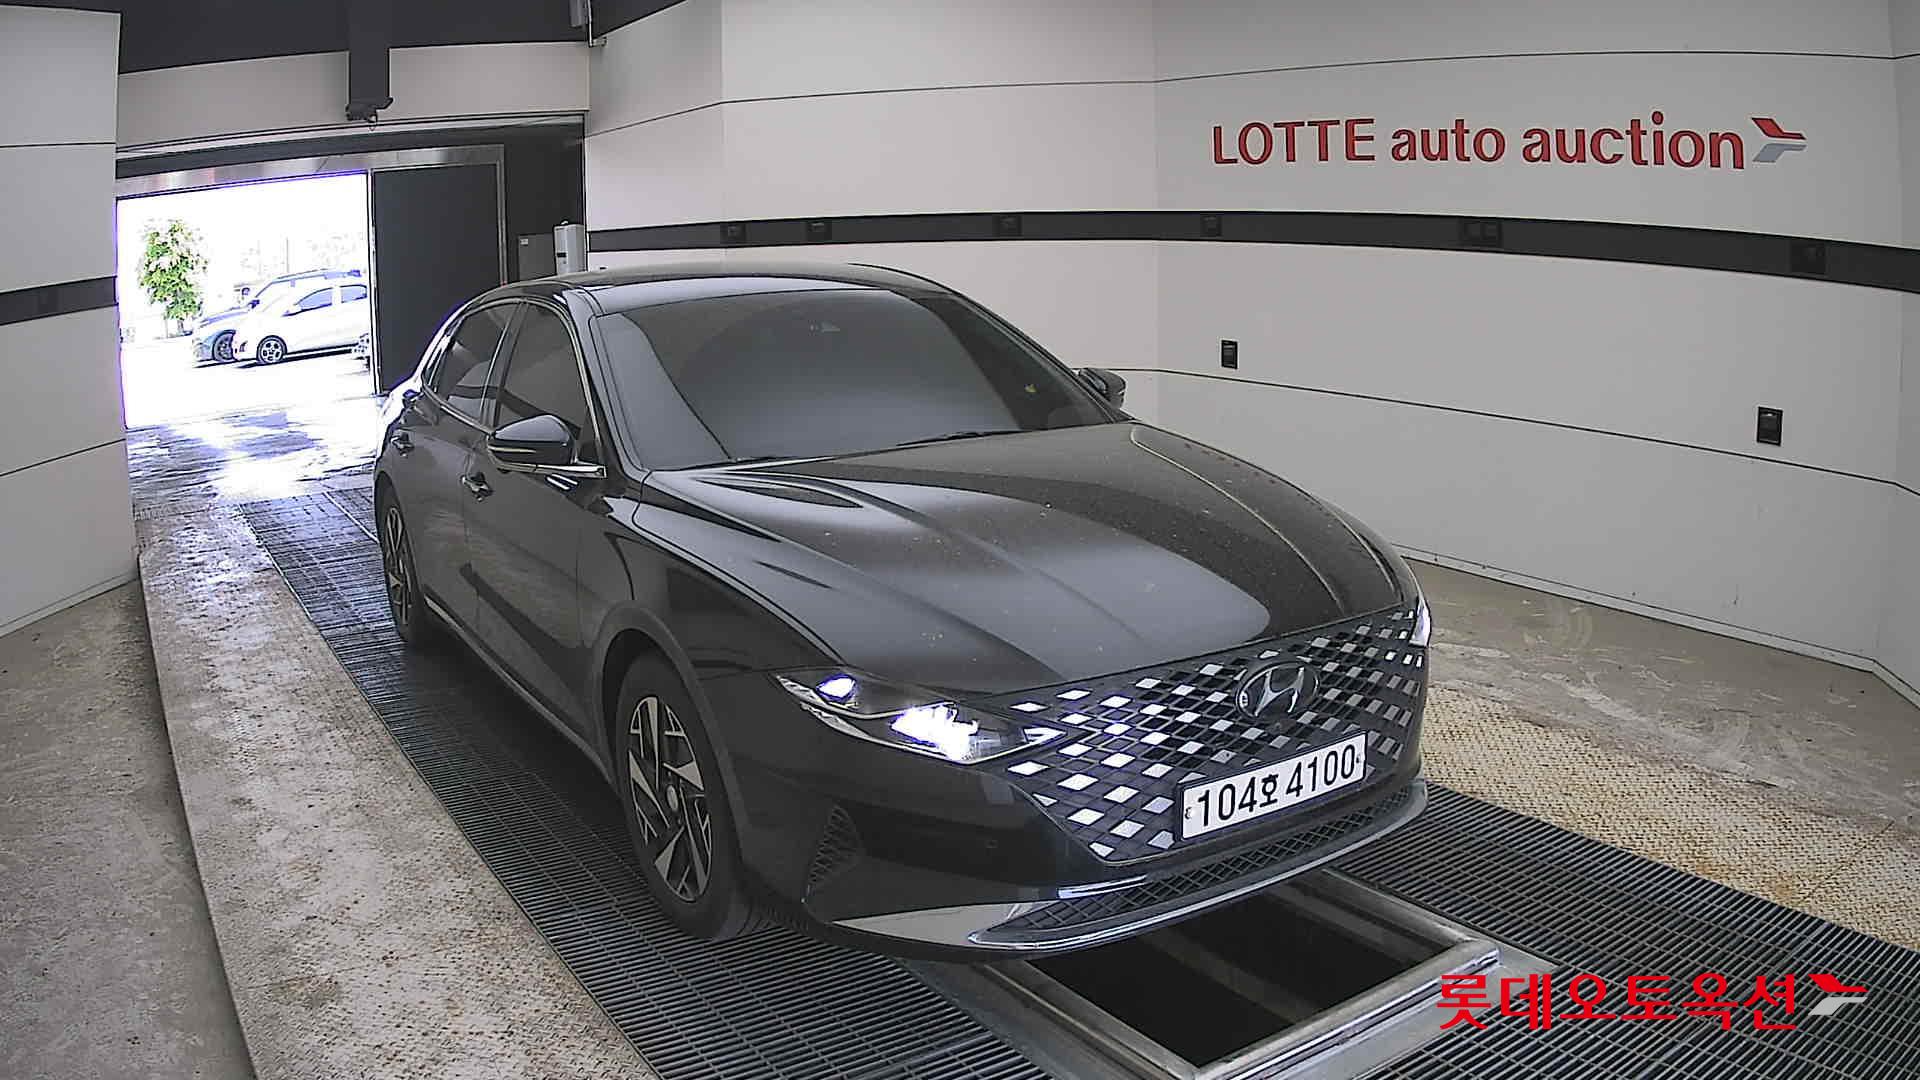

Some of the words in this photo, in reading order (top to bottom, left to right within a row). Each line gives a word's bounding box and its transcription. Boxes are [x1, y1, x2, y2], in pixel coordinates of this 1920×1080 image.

[1212, 118, 1376, 165] LOTTE
[1391, 118, 1506, 163] auto
[1522, 111, 1746, 170] auction
[1198, 774, 1279, 827] 104호
[1286, 744, 1356, 798] 4100
